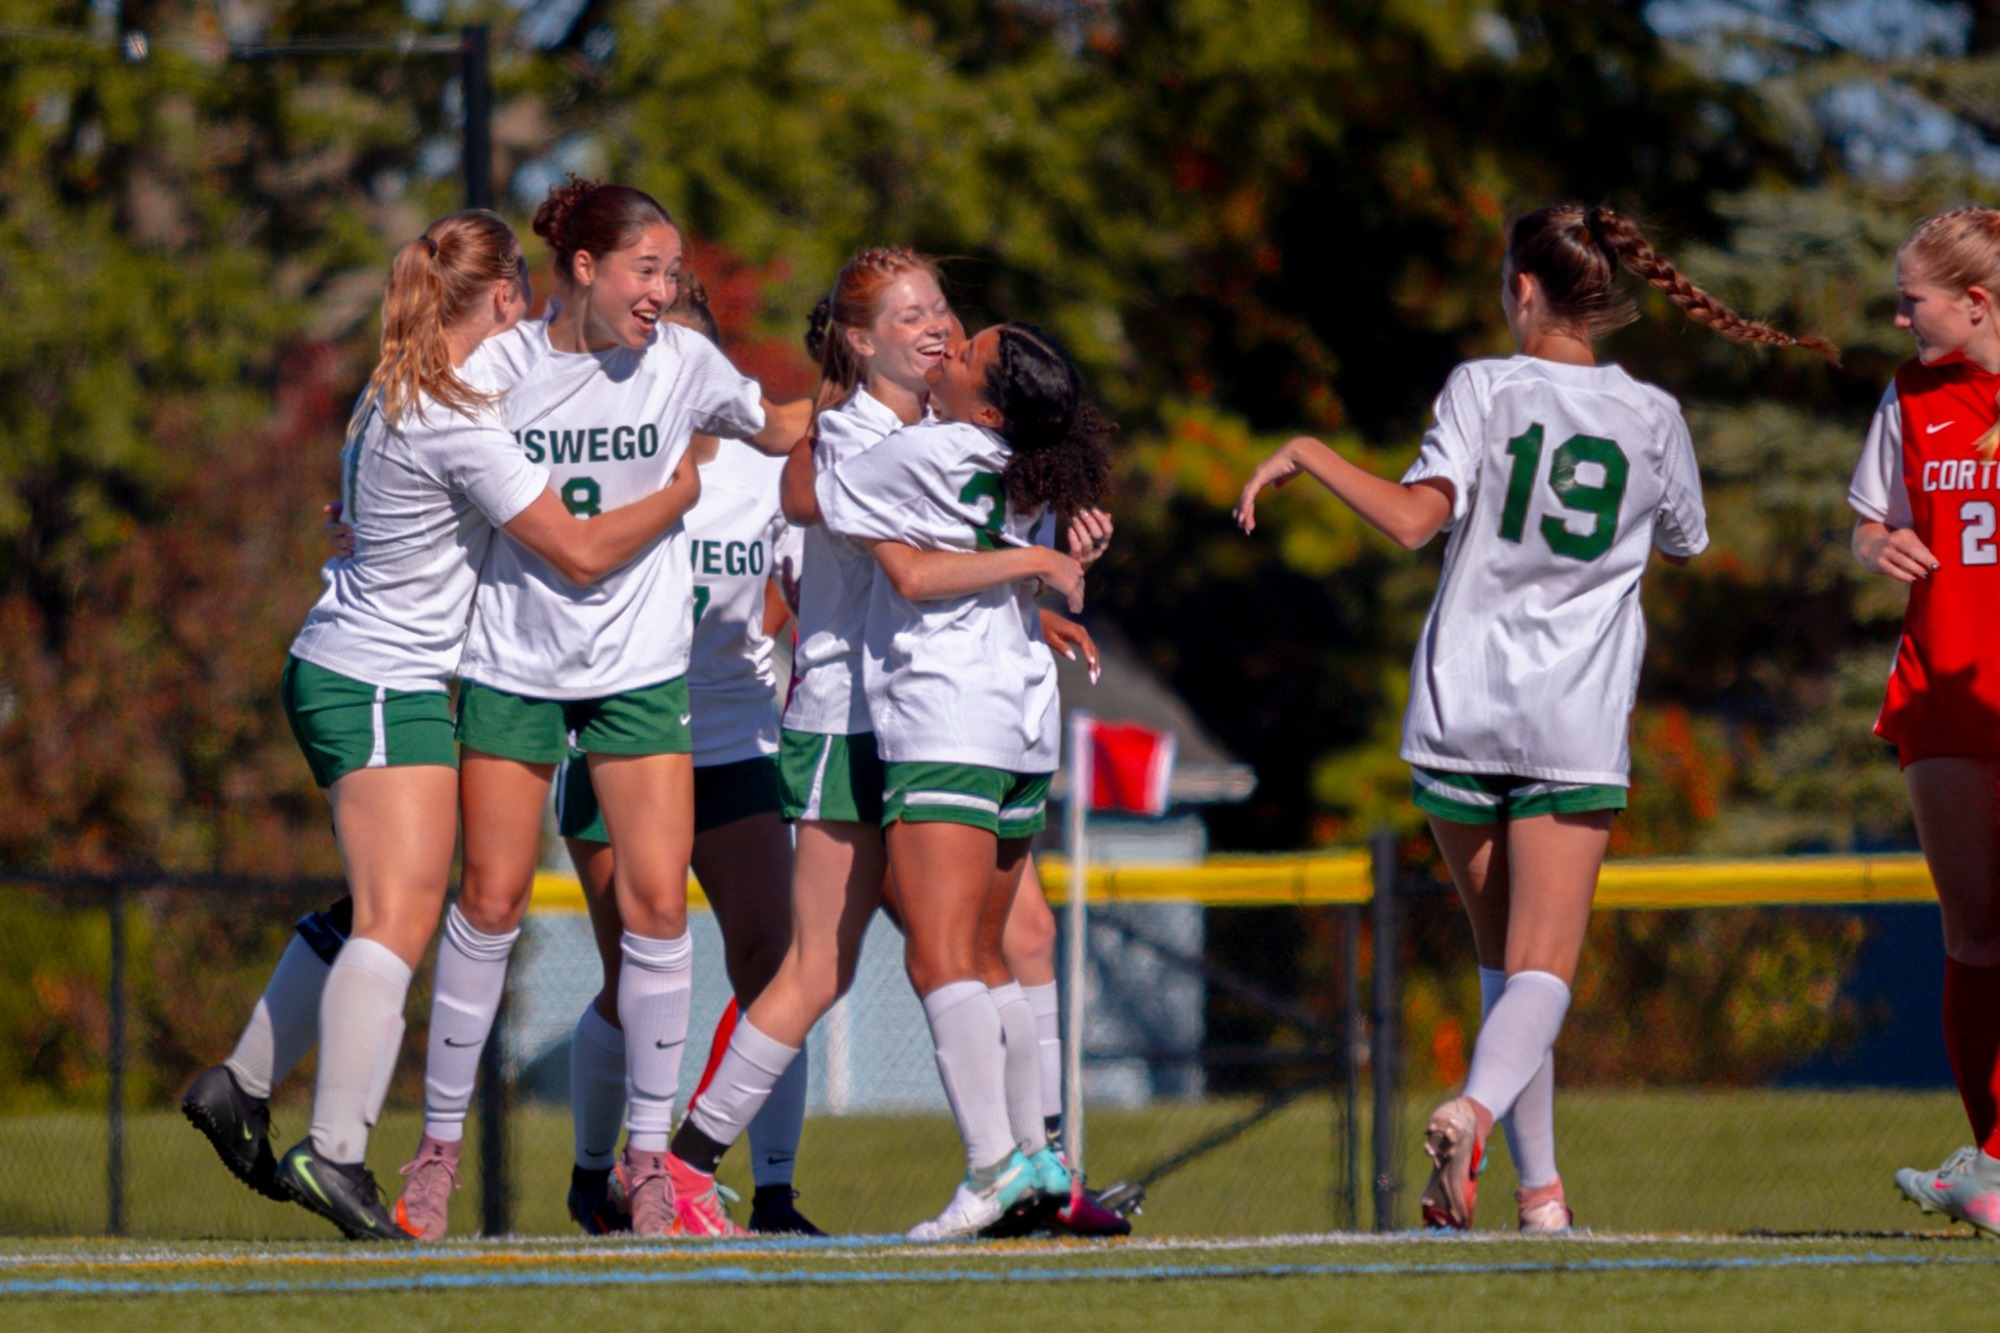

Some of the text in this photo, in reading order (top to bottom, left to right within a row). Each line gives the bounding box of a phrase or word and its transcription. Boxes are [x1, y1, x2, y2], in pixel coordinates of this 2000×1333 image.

[513, 423, 659, 464] SWEGO
[1497, 421, 1630, 563] 19
[1923, 459, 2000, 492] CORT
